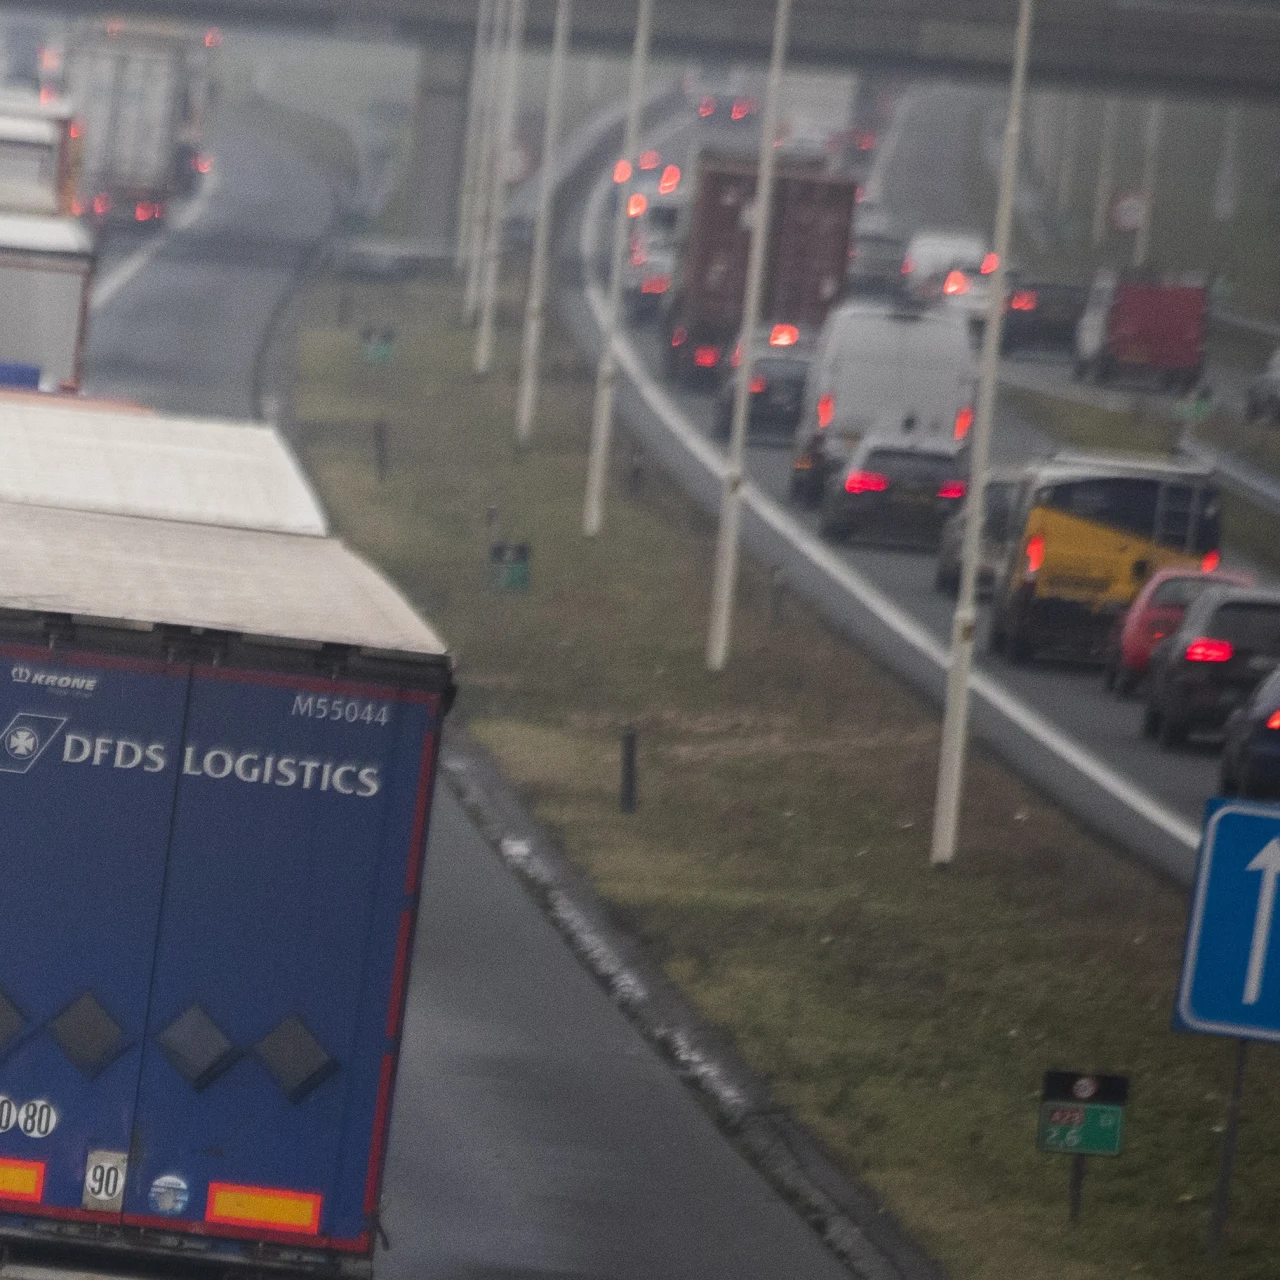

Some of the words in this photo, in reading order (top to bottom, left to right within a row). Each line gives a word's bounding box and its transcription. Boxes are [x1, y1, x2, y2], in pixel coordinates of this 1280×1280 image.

[31, 673, 98, 691] KRONE
[292, 695, 389, 727] M55044
[62, 734, 165, 773] DFDS
[182, 746, 380, 797] LOGISTICS
[23, 1102, 52, 1135] 80
[91, 1164, 119, 1197] 90
